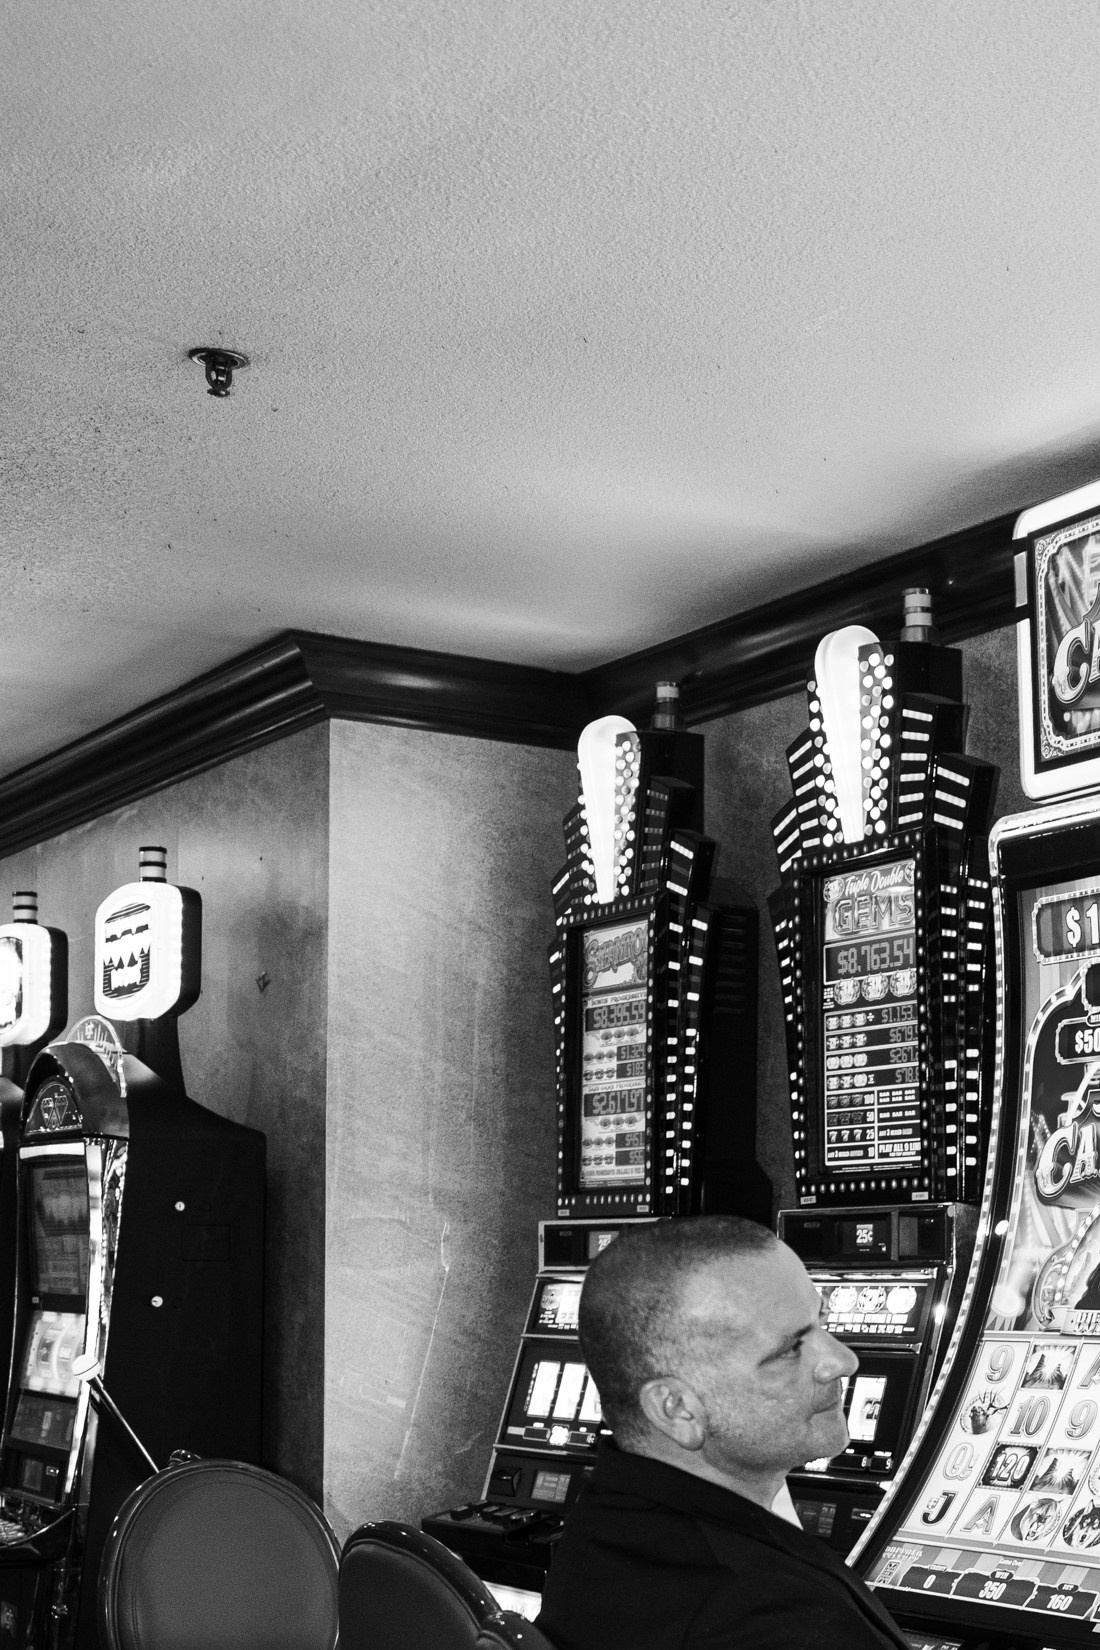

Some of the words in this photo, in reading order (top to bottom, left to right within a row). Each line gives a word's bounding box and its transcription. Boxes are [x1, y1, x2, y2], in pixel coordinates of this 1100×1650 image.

[845, 872, 870, 898] Triple
[871, 864, 904, 893] Double
[833, 894, 915, 936] GEMS
[837, 937, 914, 975] $8,763.54
[856, 1228, 874, 1245] 25¢
[985, 1344, 1015, 1384] 9
[1009, 1395, 1051, 1438] 10
[1064, 1398, 1098, 1441] 9
[942, 1441, 976, 1482] Q
[990, 1451, 1031, 1483] 120
[920, 1489, 959, 1526] J
[960, 1494, 1001, 1535] A
[923, 1574, 937, 1589] 0
[978, 1580, 1007, 1601] 350
[1046, 1593, 1074, 1611] 160
